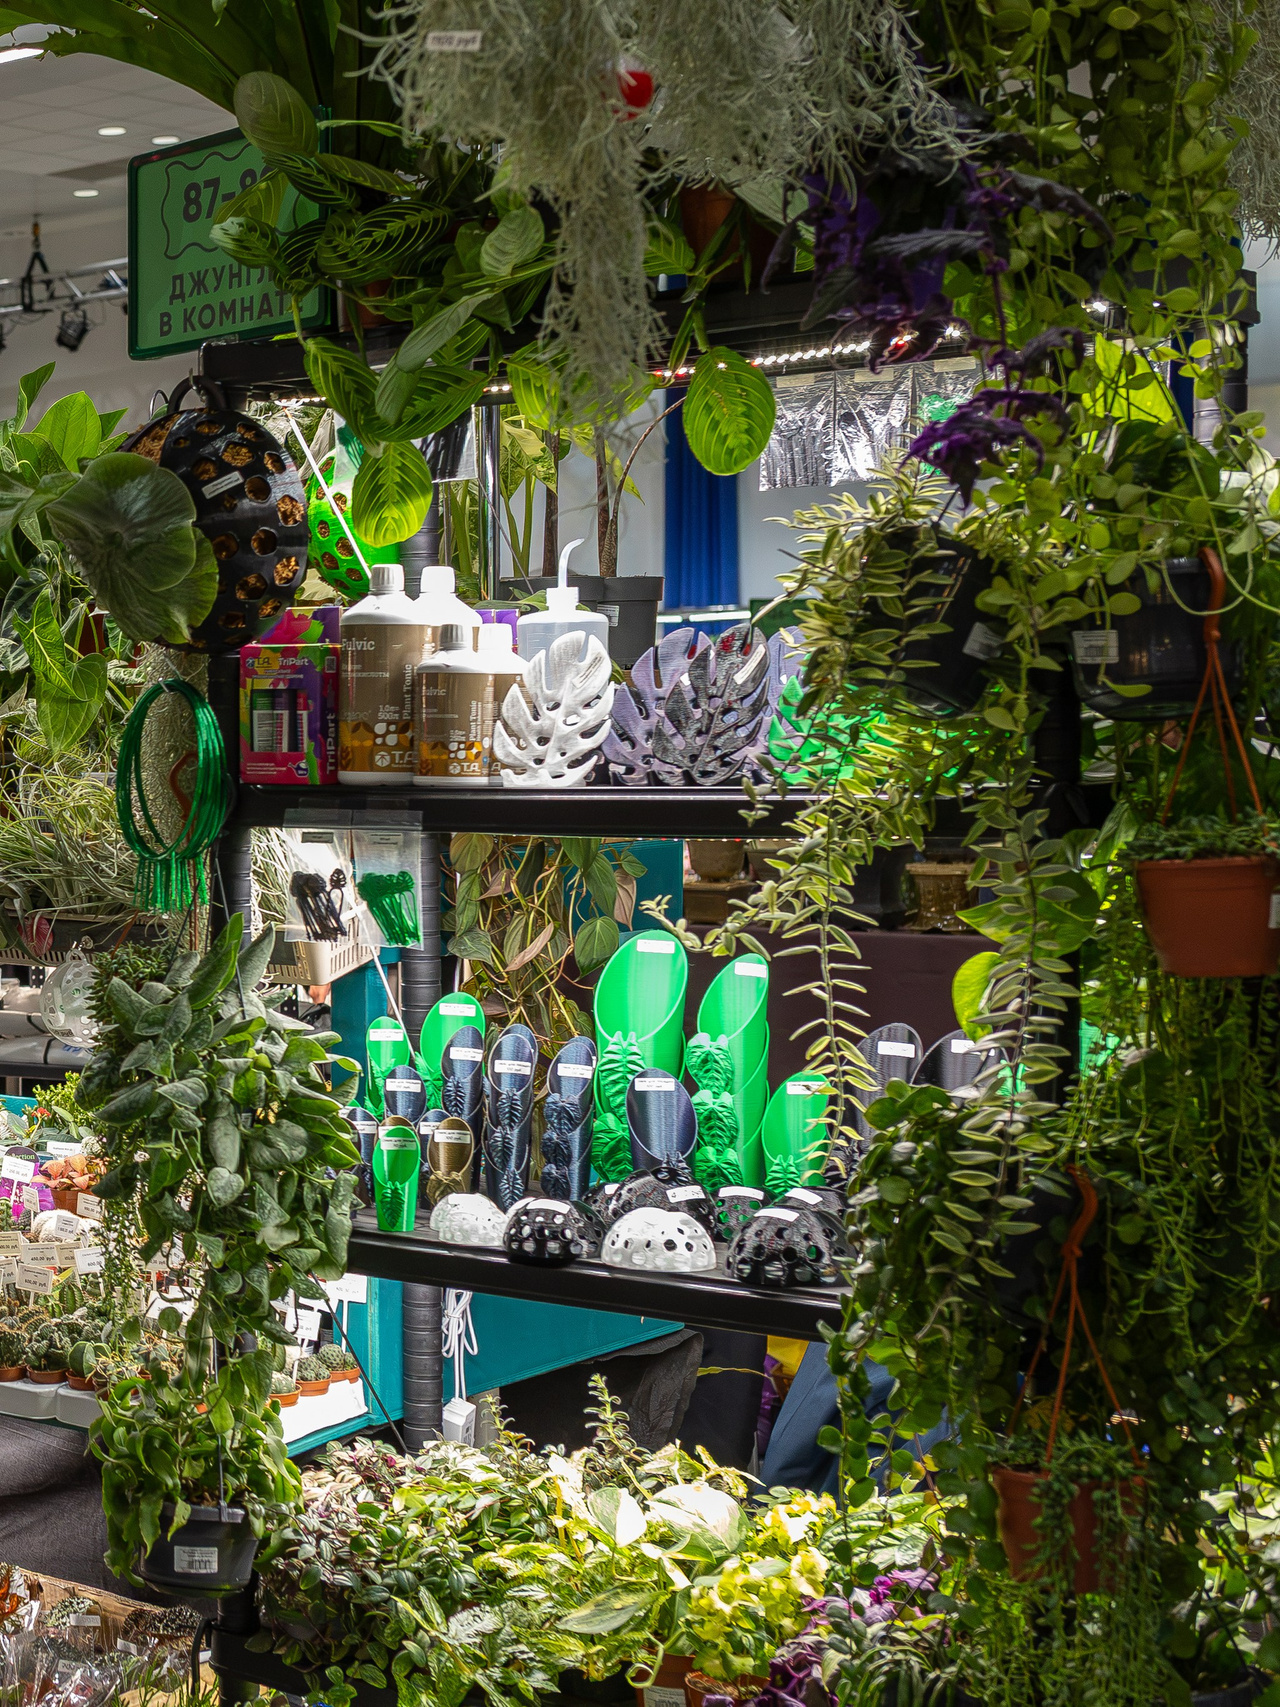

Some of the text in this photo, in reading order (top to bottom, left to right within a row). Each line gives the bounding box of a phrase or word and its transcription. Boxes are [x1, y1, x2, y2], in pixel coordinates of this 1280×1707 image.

[183, 166, 274, 223] 87-8
[169, 262, 276, 305] ДЖУНГЛ
[160, 289, 303, 337] В КОМНАТ
[278, 657, 309, 666] TriPart
[341, 637, 376, 651] Fulvic
[402, 664, 412, 720] Plant Tonic
[422, 686, 447, 696] ulvic
[468, 700, 478, 742] Plant Tonic
[326, 712, 336, 775] TriPart
